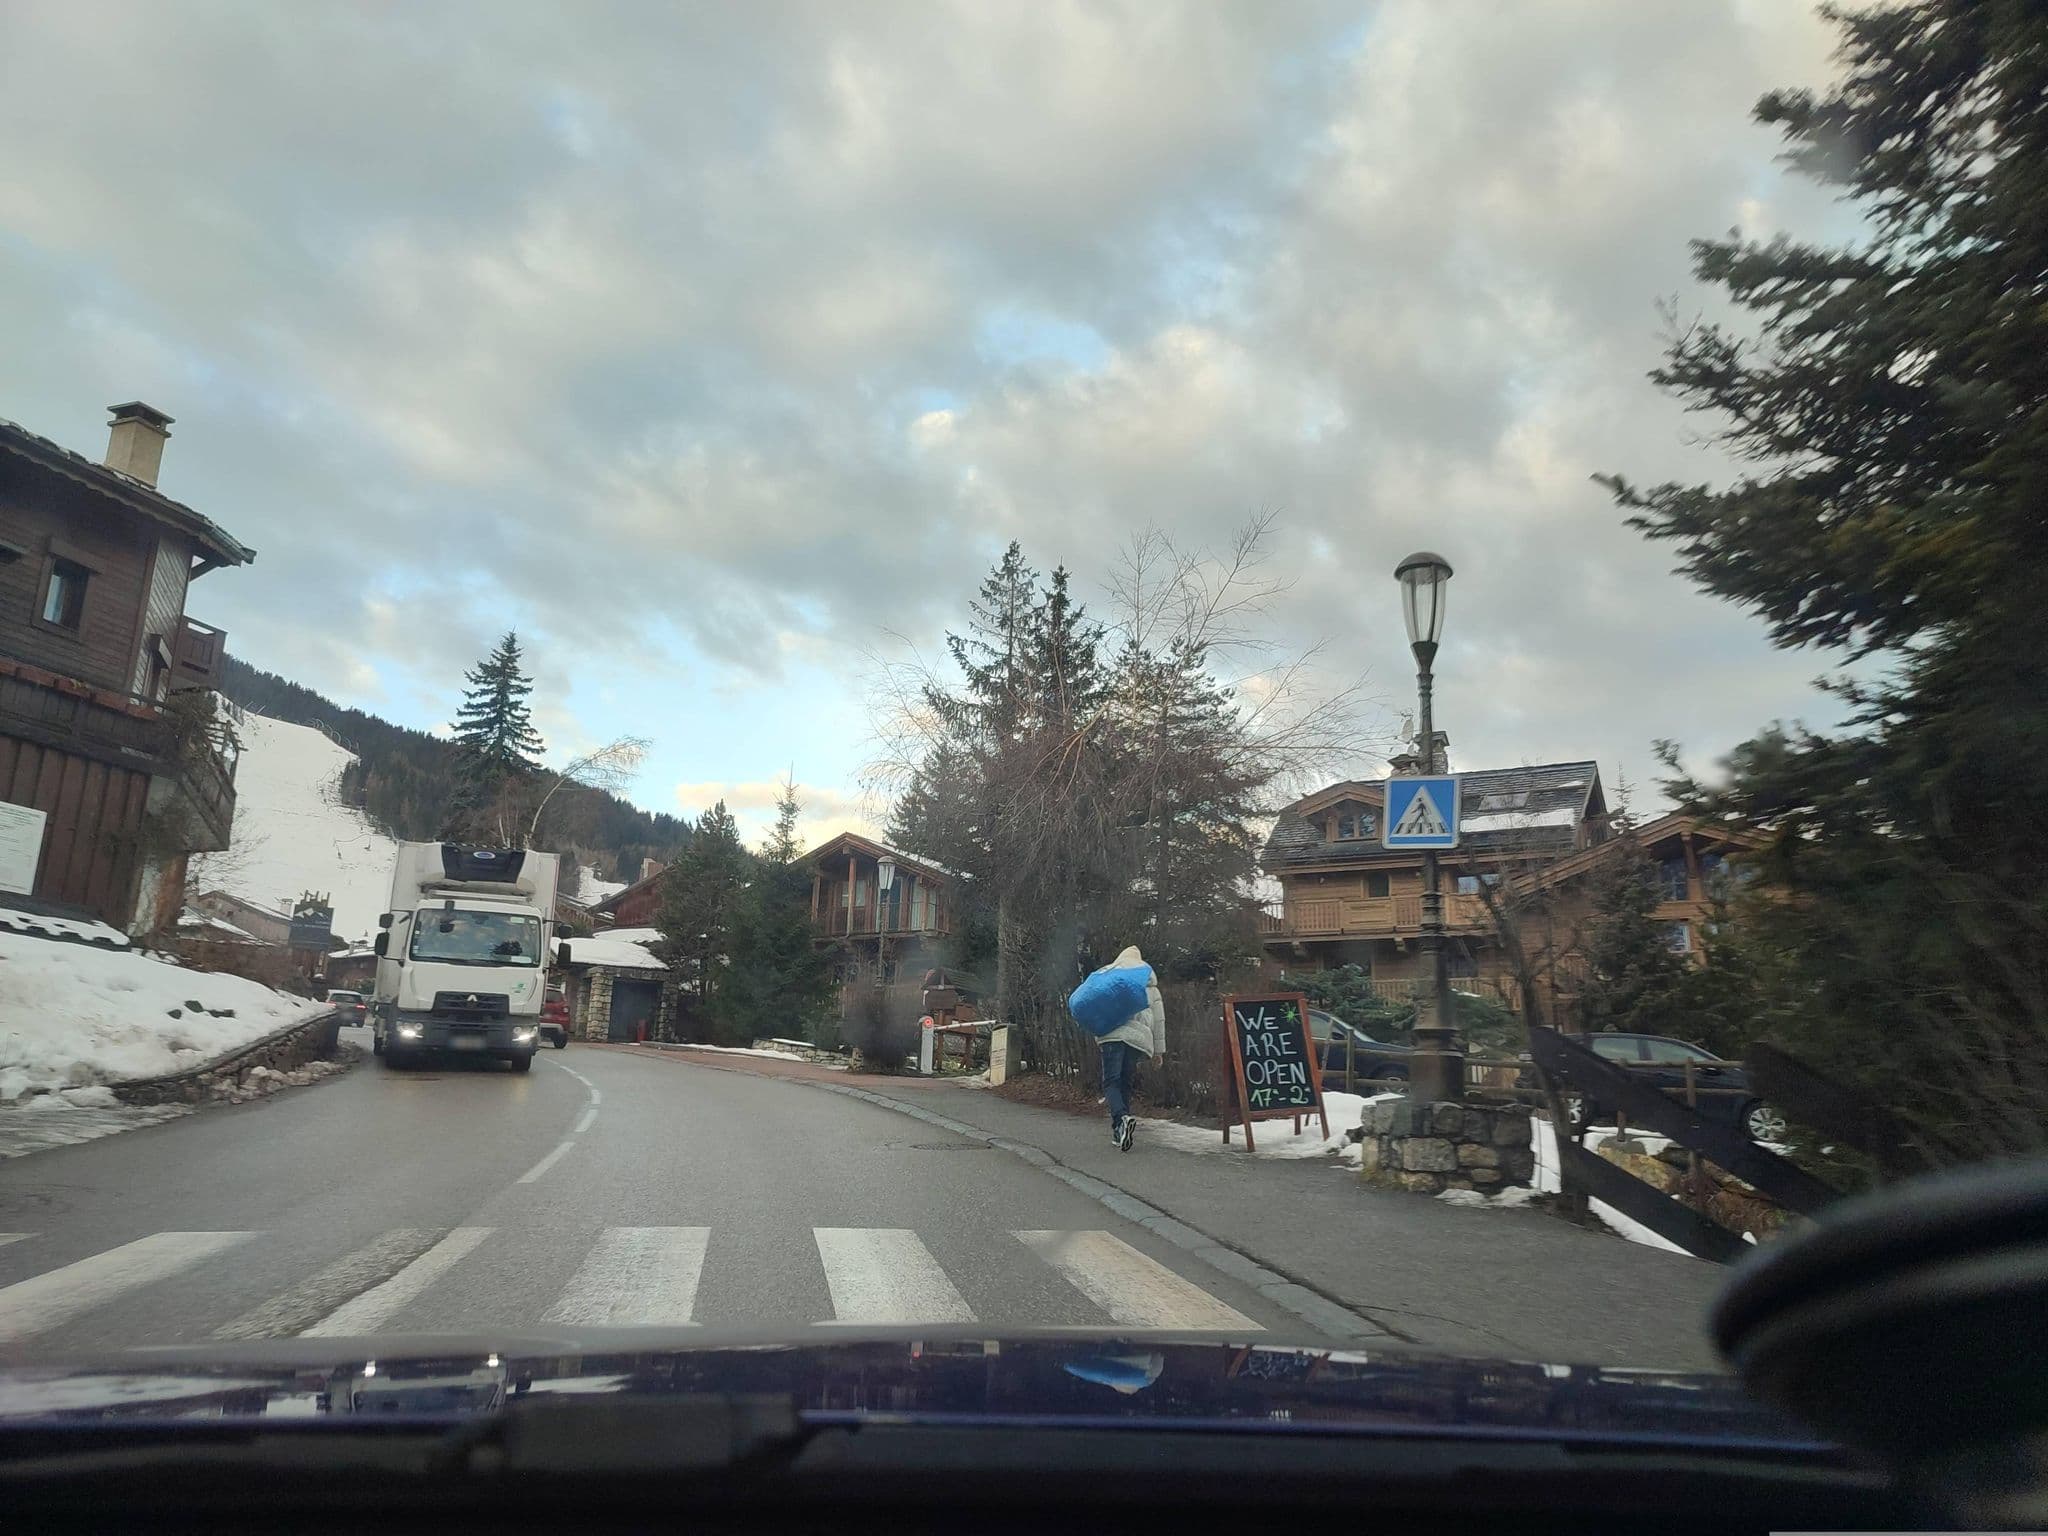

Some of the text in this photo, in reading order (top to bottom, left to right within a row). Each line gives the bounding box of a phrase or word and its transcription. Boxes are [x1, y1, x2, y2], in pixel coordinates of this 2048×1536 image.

[1236, 1006, 1279, 1031] WE
[1246, 1032, 1297, 1057] ARE
[1246, 1060, 1306, 1085] OPEN
